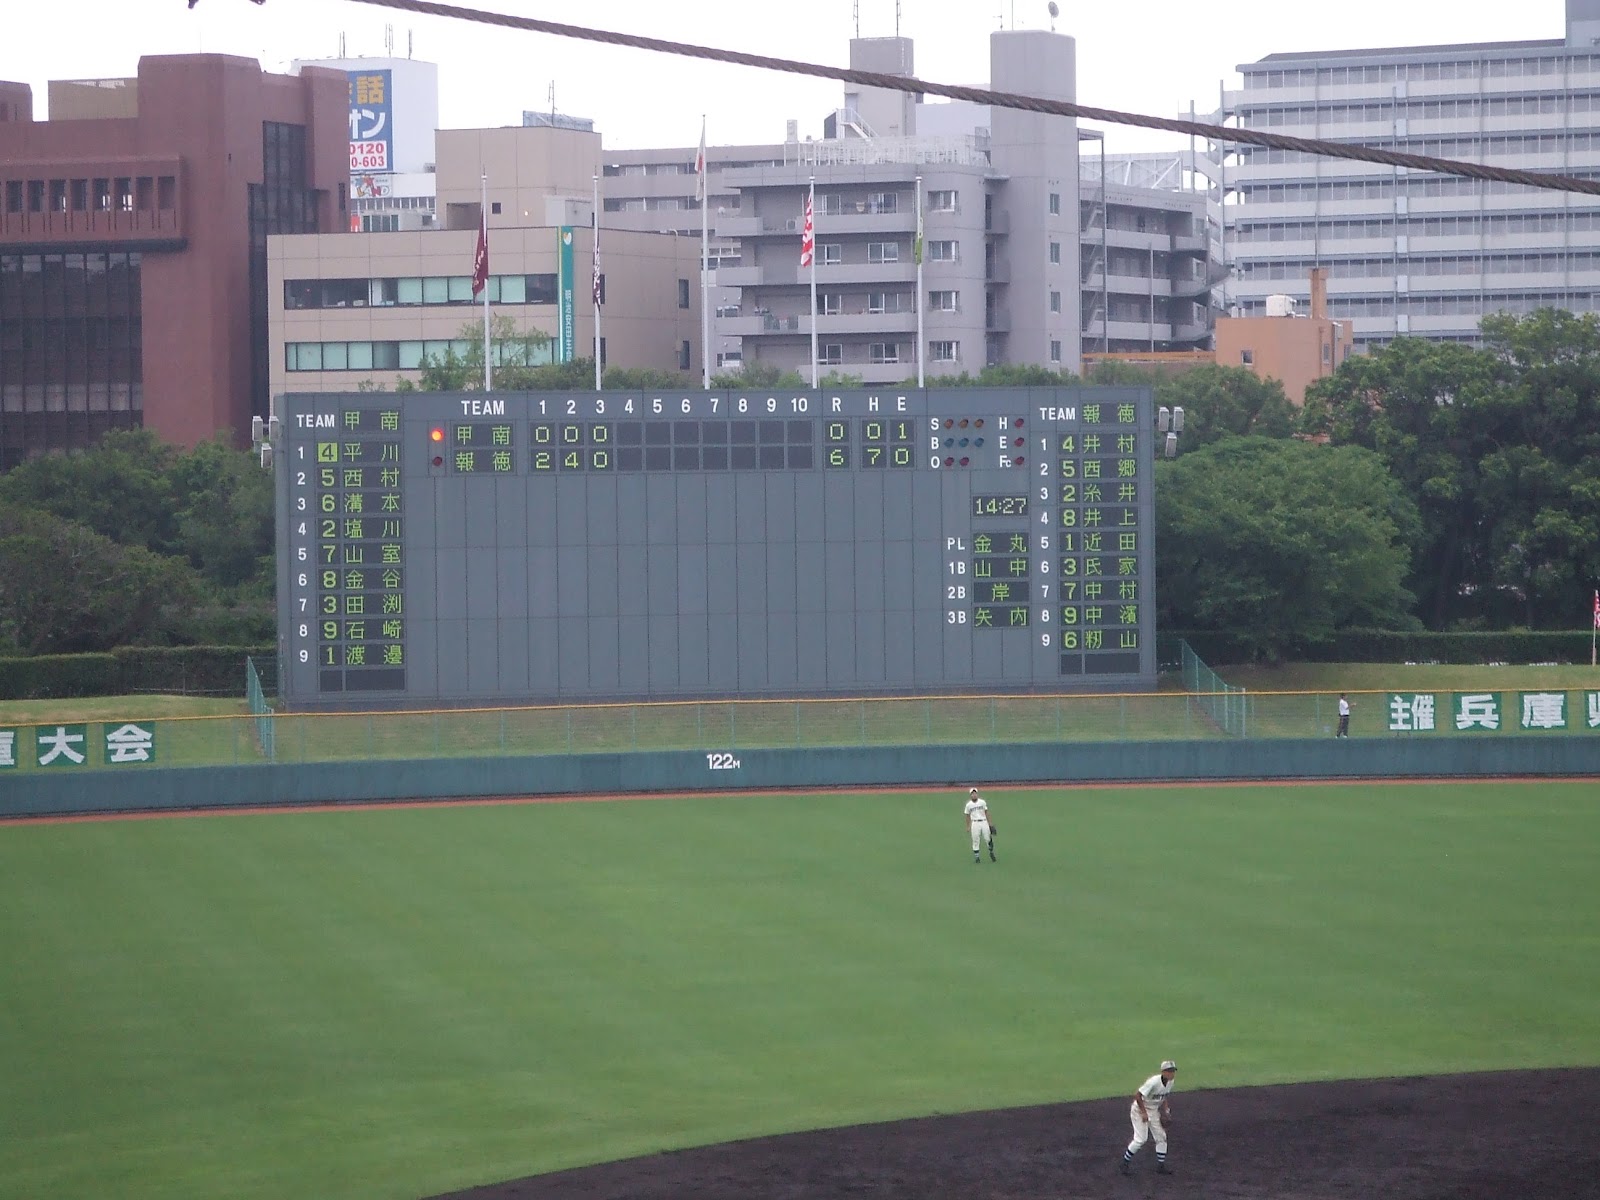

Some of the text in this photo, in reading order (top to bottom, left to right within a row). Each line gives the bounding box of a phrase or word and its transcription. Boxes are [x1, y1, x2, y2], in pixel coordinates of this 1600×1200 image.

[349, 76, 384, 104] 話
[350, 143, 385, 155] 0120
[351, 156, 385, 168] 0-603
[461, 400, 505, 415] TEAM
[539, 397, 906, 414] 1 2 3 4 5 6 7 8 9 10 R H E
[1040, 407, 1076, 420] TEAM
[296, 414, 335, 428] TEAM
[930, 417, 1008, 431] S H
[535, 426, 550, 443] 0
[564, 426, 579, 443] 0
[593, 425, 608, 442] 0
[829, 423, 844, 440] 0
[866, 423, 881, 439] 0
[898, 422, 907, 439] 1
[298, 446, 304, 459] 1
[322, 443, 334, 460] 4
[931, 436, 1007, 450] B E
[1041, 438, 1047, 451] 1
[1062, 435, 1075, 453] 4
[535, 452, 550, 469] 2
[564, 451, 579, 469] 4
[593, 451, 608, 468] 0
[829, 449, 844, 465] 6
[867, 448, 881, 464] 7
[895, 448, 909, 464] 0
[1040, 463, 1048, 475] 2
[1063, 460, 1075, 478] 5
[297, 472, 306, 485] 2
[322, 469, 335, 487] 5
[1040, 487, 1048, 500] 3
[1063, 485, 1075, 502] 2
[297, 497, 306, 510] 3
[322, 494, 335, 512] 6
[976, 498, 1027, 514] 14:27
[1041, 512, 1049, 525] 4
[1063, 509, 1076, 526] 8
[298, 522, 307, 535] 4
[322, 519, 336, 538] 2
[947, 537, 966, 550] PL
[1041, 536, 1049, 549] 5
[1065, 533, 1074, 551] 1
[298, 547, 307, 561] 5
[322, 545, 336, 563] 7
[949, 561, 966, 575] 1B
[1041, 560, 1049, 573] 6
[1064, 558, 1077, 575] 3
[298, 573, 307, 586] 6
[323, 570, 337, 588] 8
[947, 586, 966, 599] 2B
[1041, 585, 1049, 598] 7
[1064, 582, 1077, 600] 7
[299, 598, 307, 612] 7
[323, 596, 337, 614] 3
[947, 610, 966, 624] 3B
[1041, 609, 1050, 622] 8
[1064, 607, 1077, 624] 9
[299, 624, 308, 637] 8
[323, 621, 337, 639] 9
[1041, 634, 1050, 647] 9
[1064, 631, 1077, 649] 6
[299, 649, 308, 663] 9
[326, 646, 335, 665] 1
[1389, 693, 1435, 730] 主催
